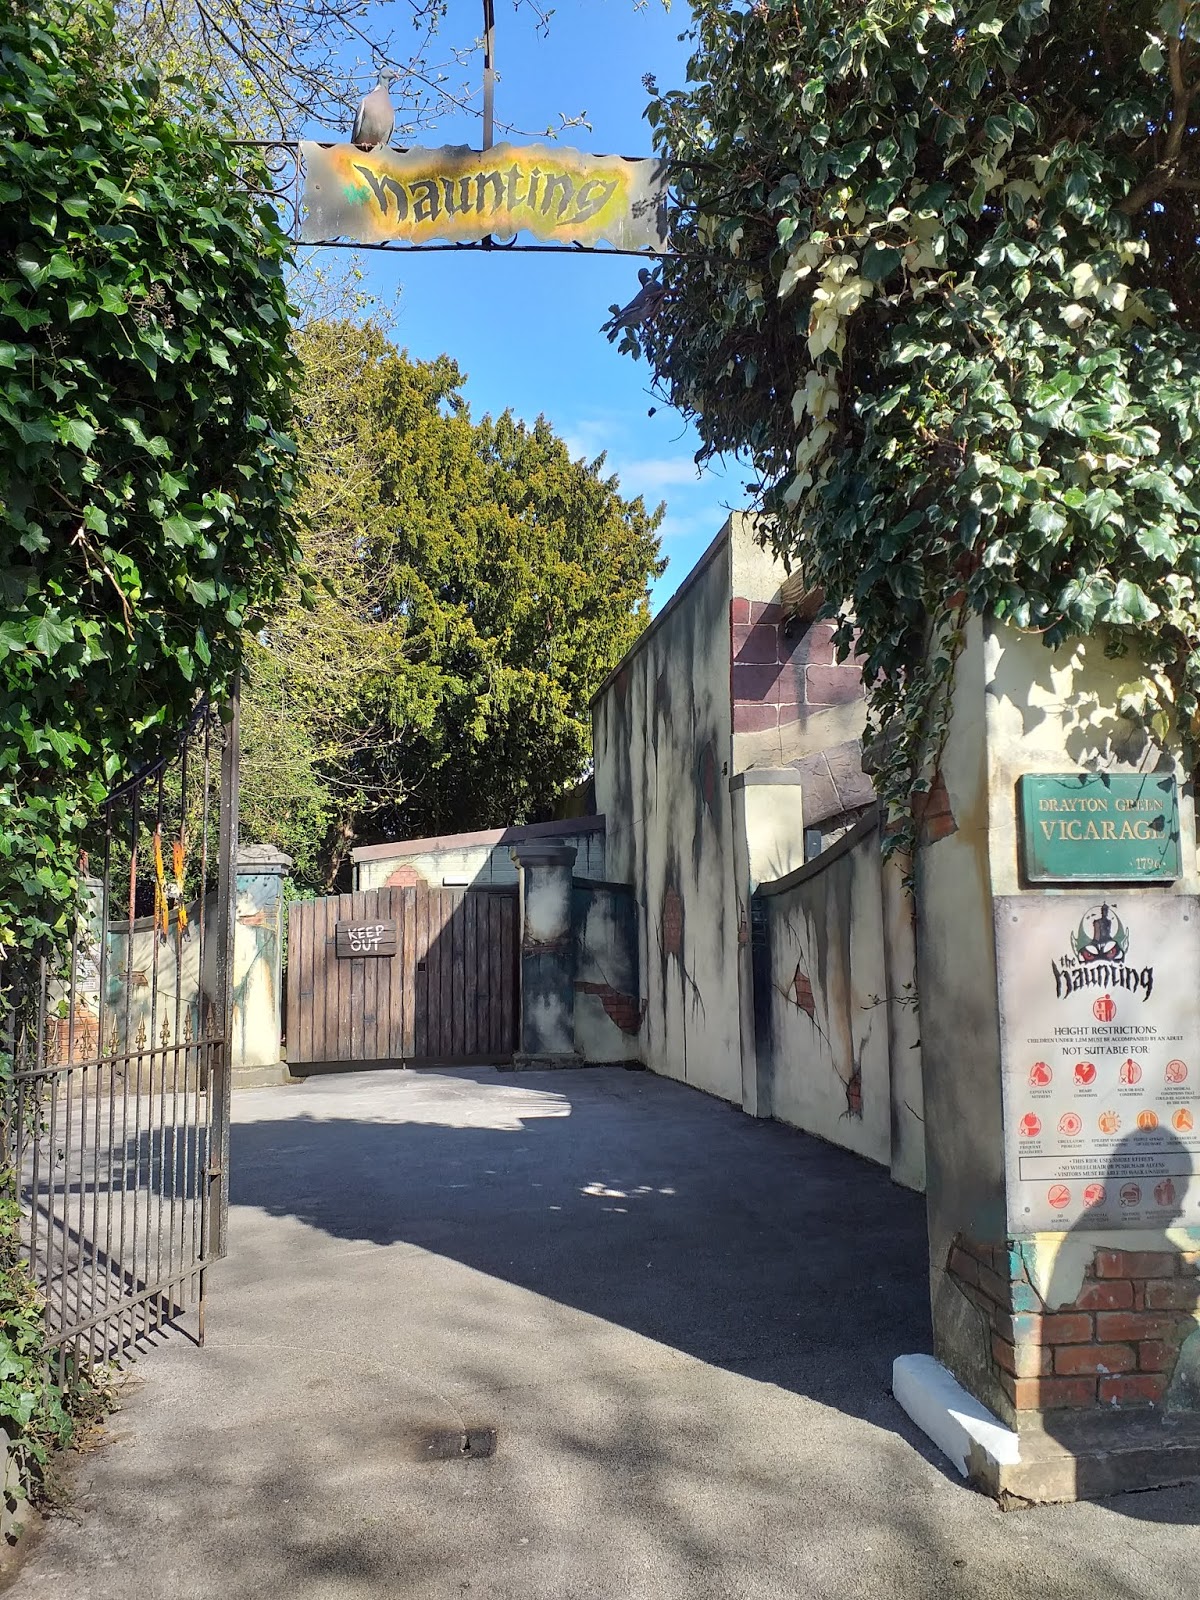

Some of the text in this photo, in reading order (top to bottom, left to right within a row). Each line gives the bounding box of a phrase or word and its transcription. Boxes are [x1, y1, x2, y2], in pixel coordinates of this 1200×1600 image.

[353, 162, 619, 226] haunting
[1038, 798, 1163, 812] DRAYTON GREEN
[348, 925, 384, 940] KEEP
[351, 938, 383, 951] OUT
[1060, 953, 1076, 968] the
[1051, 959, 1154, 1002] haunting
[1054, 1025, 1158, 1036] HEIGHT RESTRICTIONS
[1062, 1046, 1082, 1055] NOT
[1084, 1045, 1129, 1055] SUITABLE
